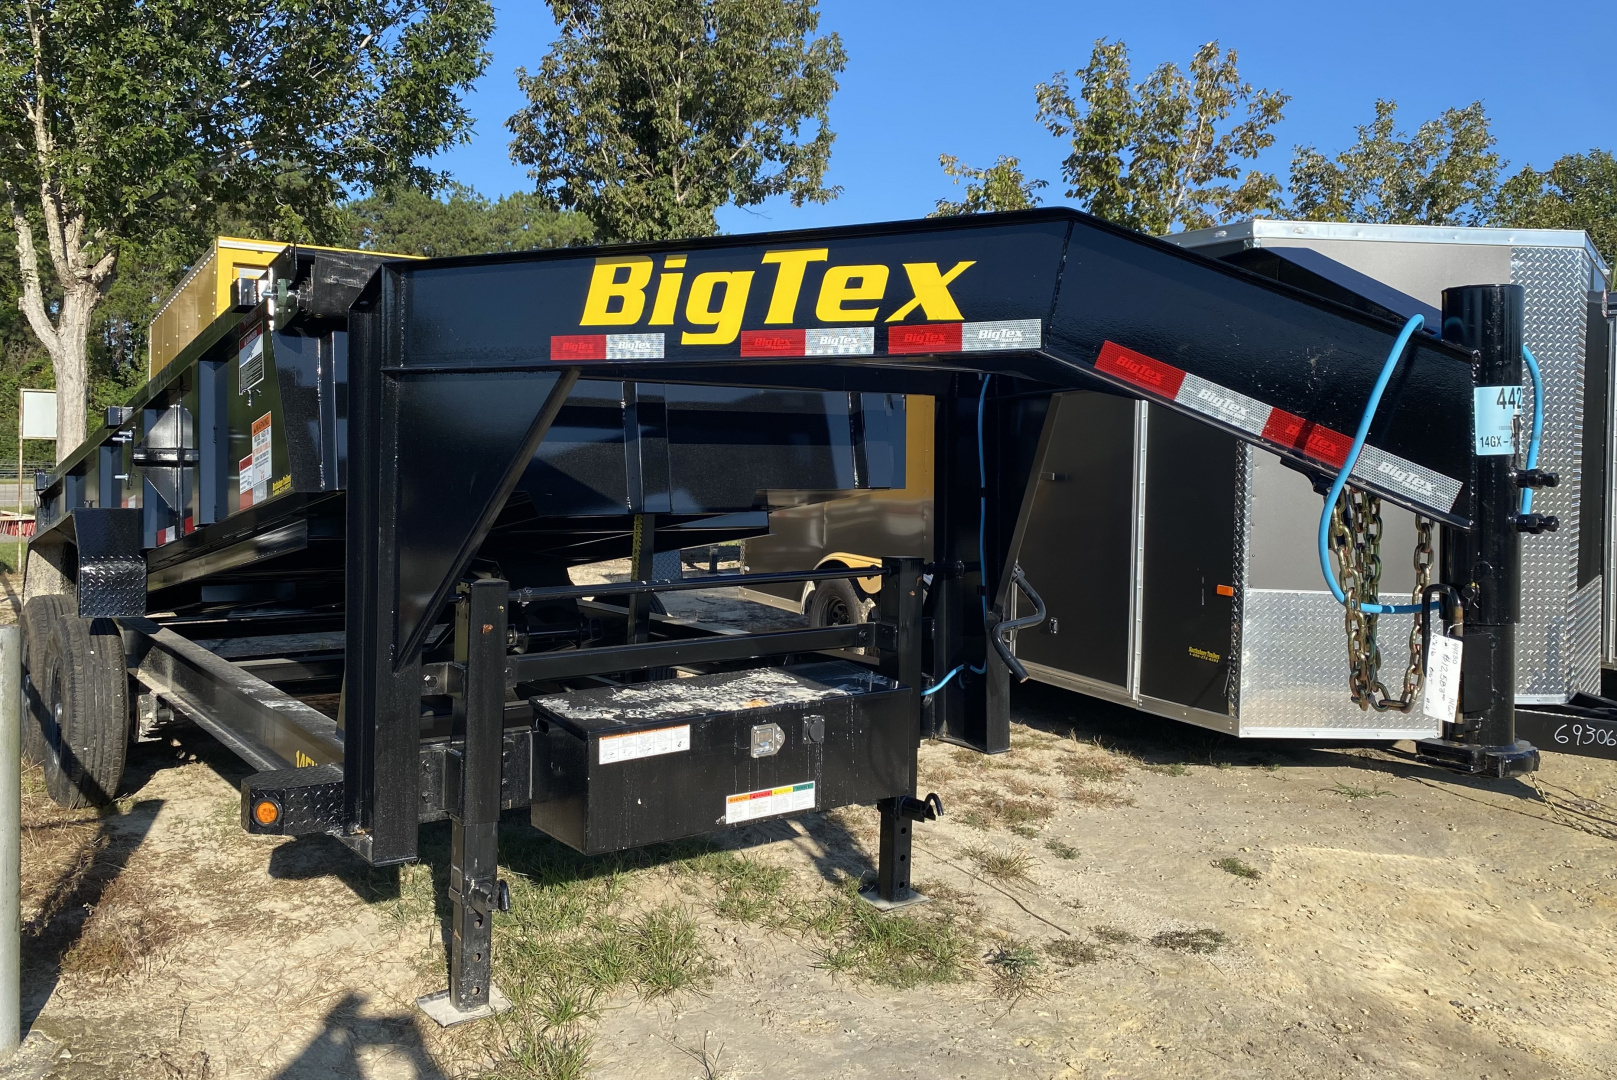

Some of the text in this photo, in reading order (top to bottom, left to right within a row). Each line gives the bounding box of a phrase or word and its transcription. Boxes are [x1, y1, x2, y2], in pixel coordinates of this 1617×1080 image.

[579, 247, 977, 345] BigTex
[904, 332, 946, 344] BigTex
[978, 329, 1023, 341] BigTex
[562, 342, 595, 352] BigTex
[618, 341, 652, 351] BigTex
[754, 338, 791, 348] BigTex
[820, 336, 858, 347] BigTex
[1115, 355, 1164, 381] BigTex
[1197, 388, 1250, 415] BigTex
[1377, 462, 1437, 492] BigTex
